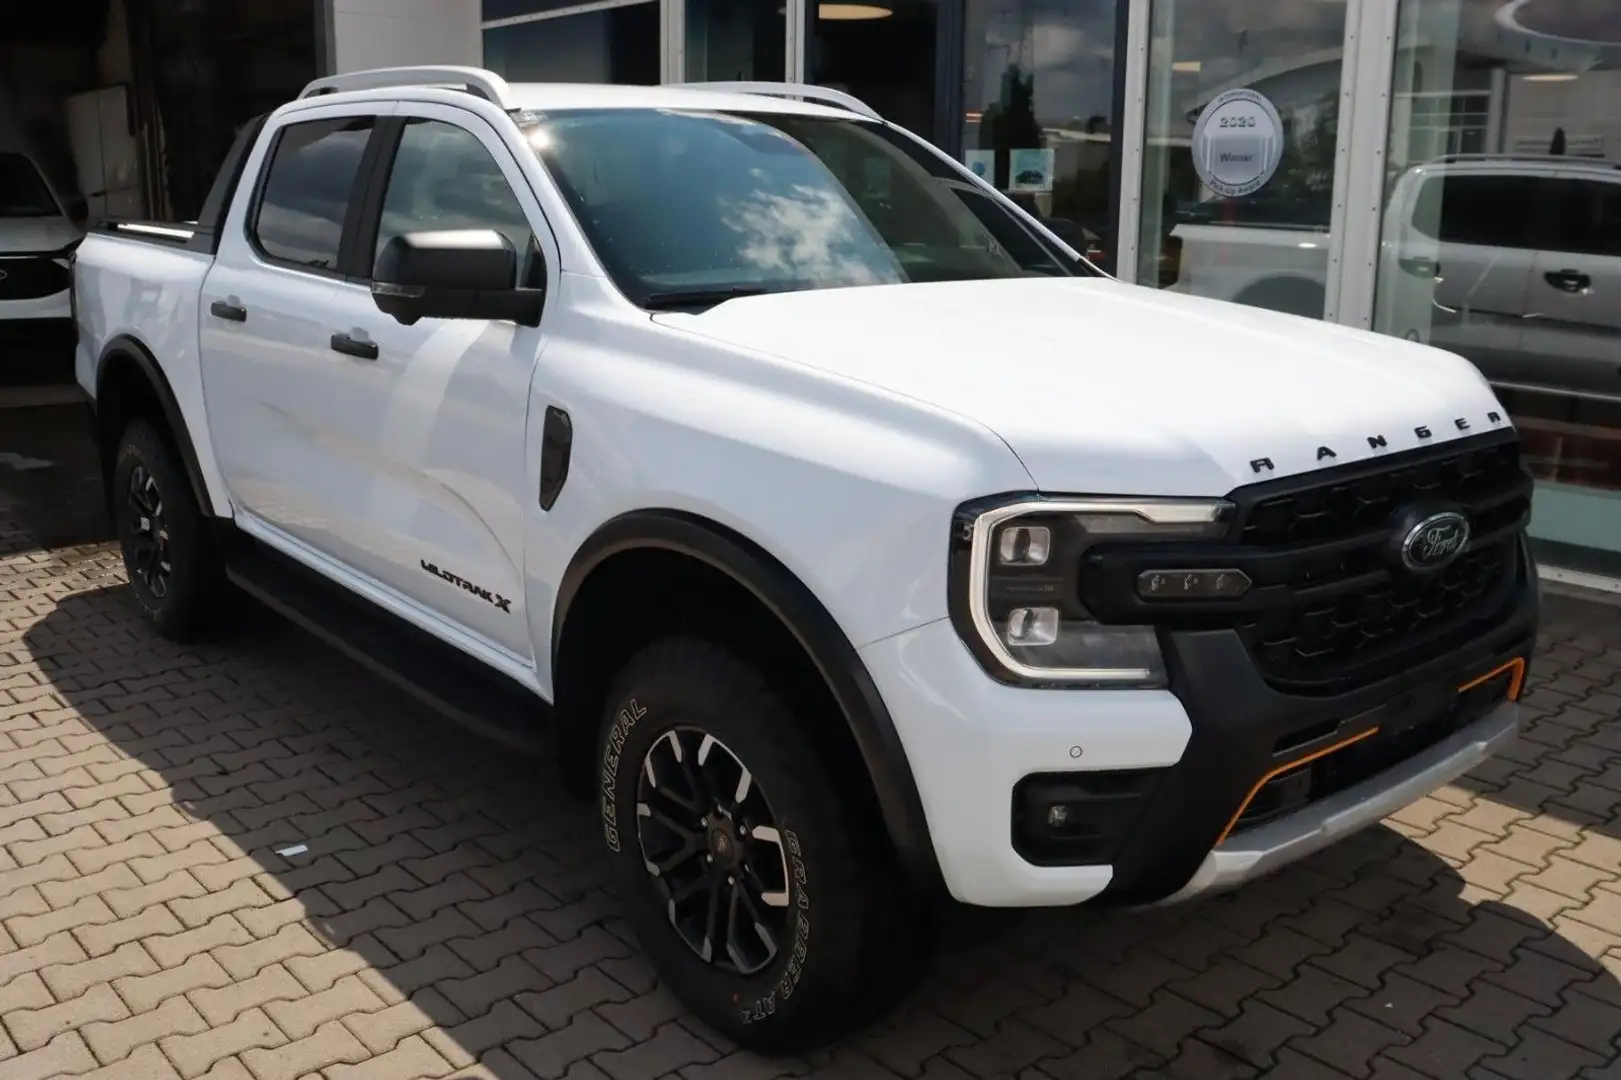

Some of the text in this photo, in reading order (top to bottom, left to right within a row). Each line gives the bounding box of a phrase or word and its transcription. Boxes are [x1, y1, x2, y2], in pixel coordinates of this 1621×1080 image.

[1219, 116, 1255, 128] 2020
[1220, 152, 1253, 163] Winner
[1249, 411, 1501, 473] RANGER
[1422, 524, 1459, 558] Ford
[420, 559, 511, 613] WILDTRAK X
[602, 698, 648, 852] GENERAL
[782, 829, 809, 1000] GRABBER
